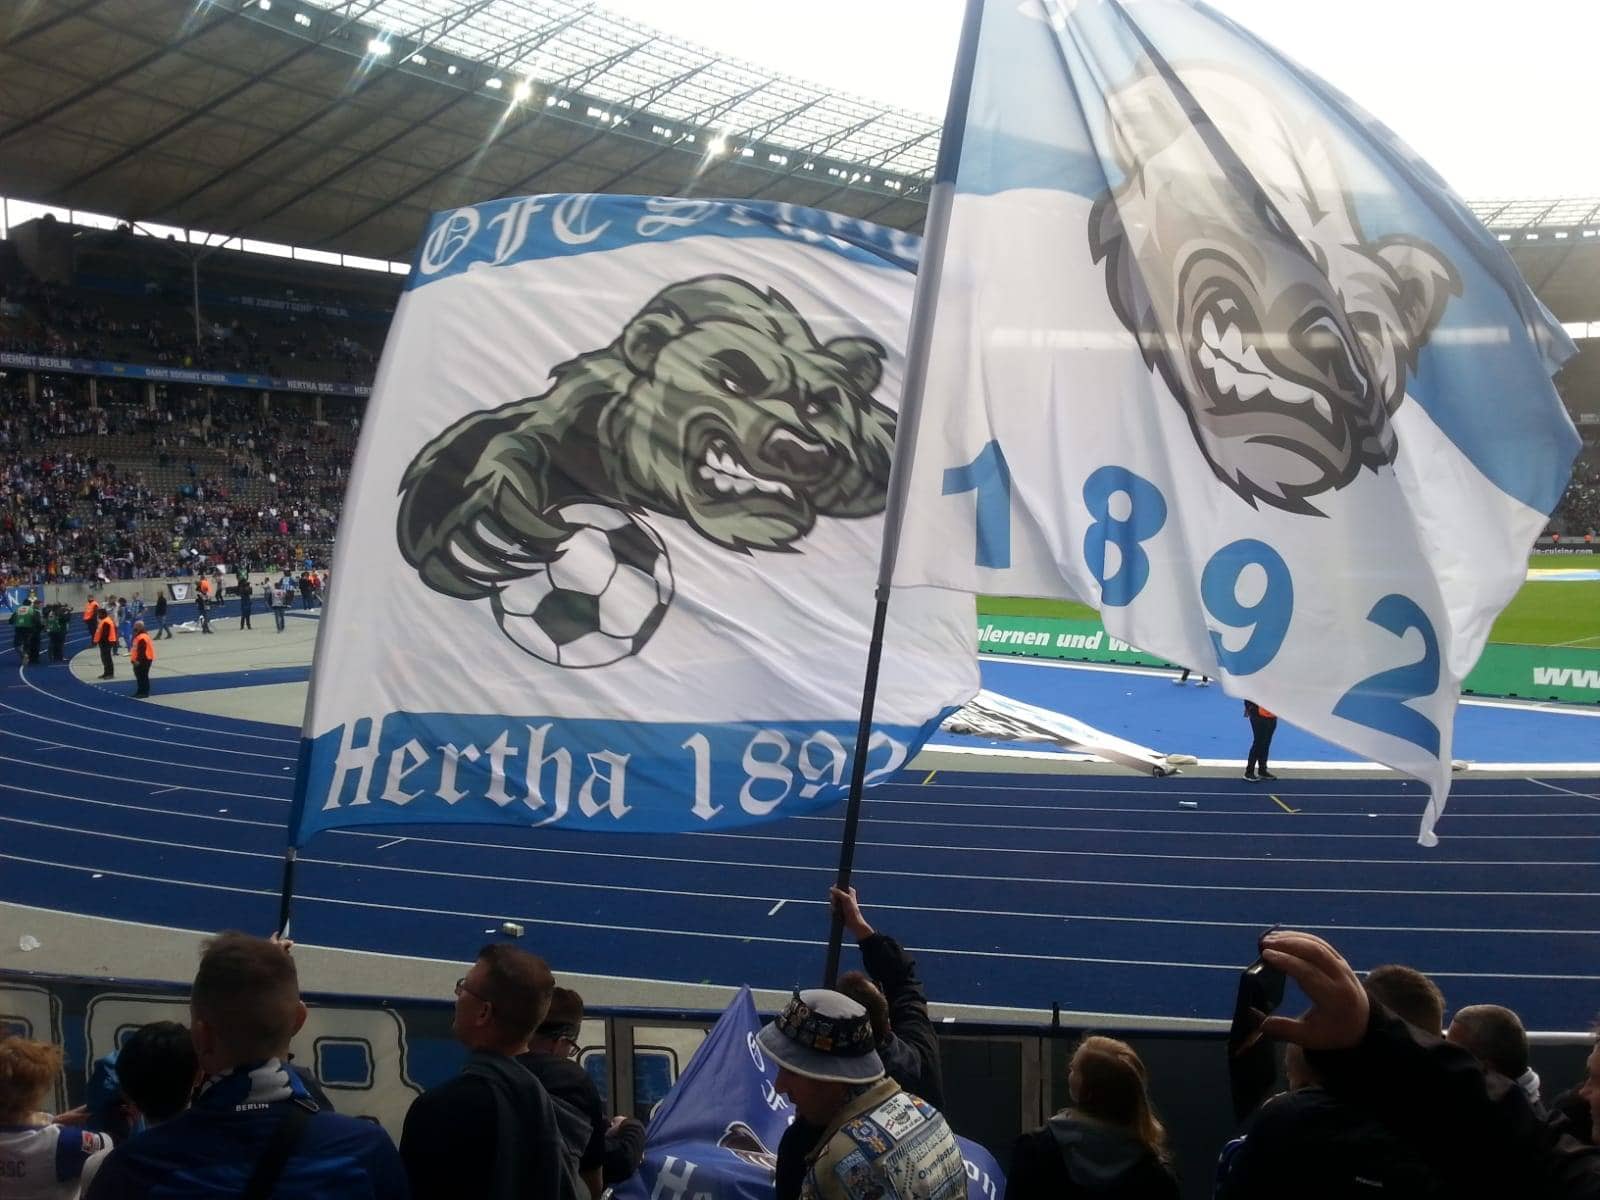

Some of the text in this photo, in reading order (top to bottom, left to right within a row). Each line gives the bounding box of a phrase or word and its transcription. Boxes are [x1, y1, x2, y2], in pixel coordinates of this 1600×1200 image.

[1056, 631, 1104, 651] und
[322, 713, 633, 826] Hertha
[235, 1103, 270, 1112] BERLIN
